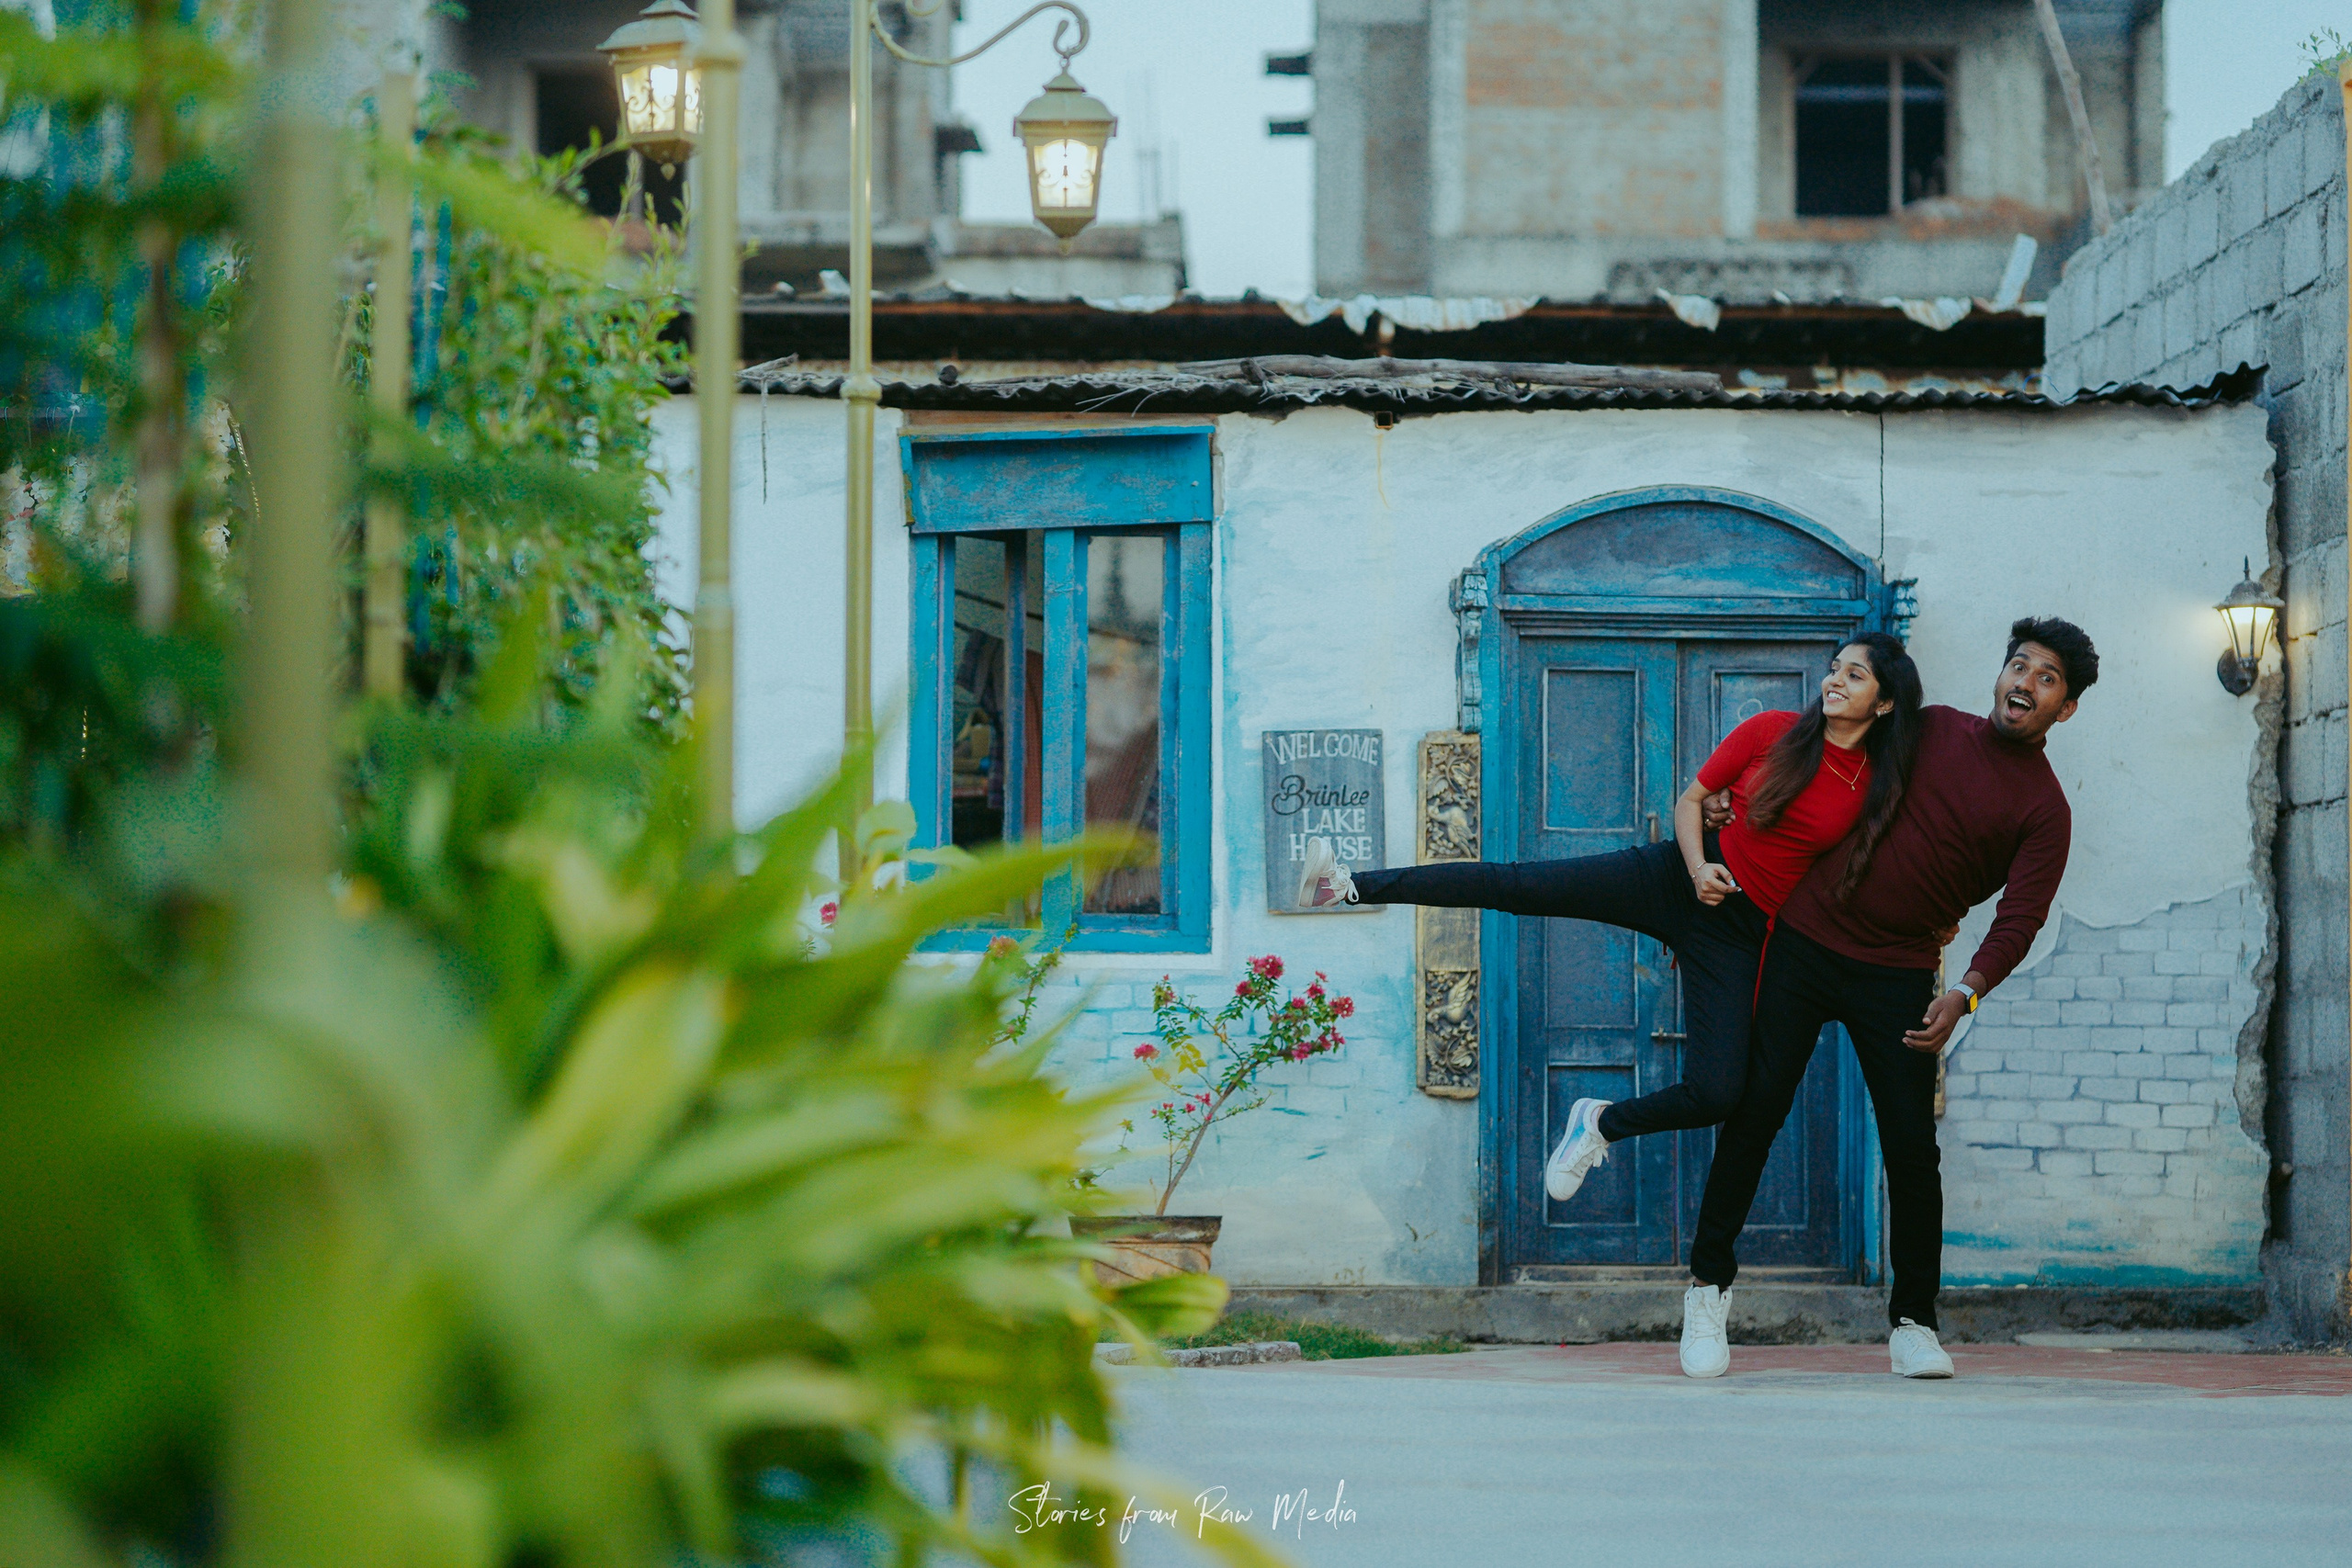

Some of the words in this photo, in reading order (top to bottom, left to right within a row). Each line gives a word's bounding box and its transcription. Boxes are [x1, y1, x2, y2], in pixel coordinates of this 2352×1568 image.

[1265, 732, 1378, 765] WELCOME
[1272, 774, 1370, 816] Brinlee
[1303, 807, 1365, 833] LAKE
[1289, 833, 1373, 862] HUSE
